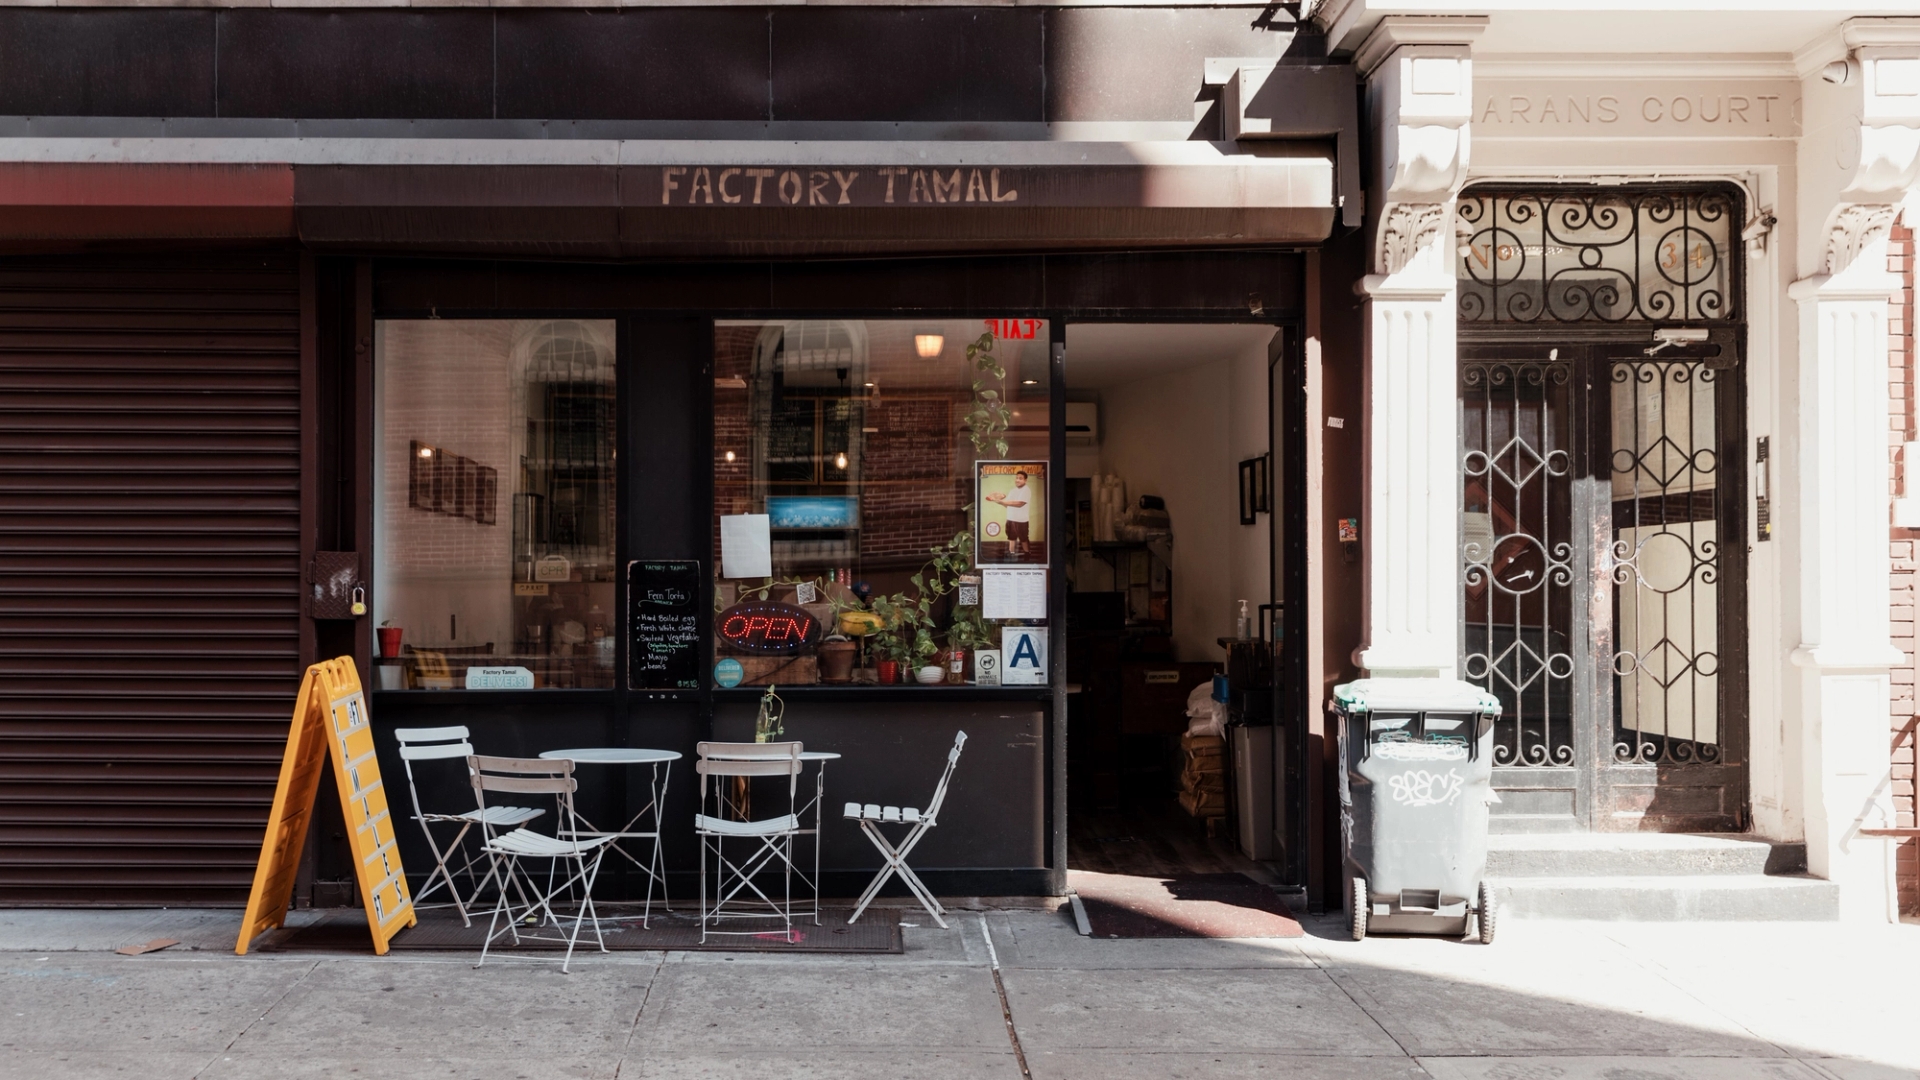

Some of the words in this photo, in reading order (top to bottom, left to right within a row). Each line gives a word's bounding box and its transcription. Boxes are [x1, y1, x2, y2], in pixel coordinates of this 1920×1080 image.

[1471, 95, 1619, 123] ARANS
[1641, 95, 1779, 123] COURT
[662, 167, 859, 206] FACTORY
[877, 167, 1018, 204] TAMAL
[984, 465, 1016, 474] FACTORY
[541, 565, 564, 576] CPR
[665, 587, 685, 600] Torta
[659, 614, 679, 622] Boiled
[682, 616, 696, 626] egg
[723, 615, 810, 640] OPEN
[1009, 634, 1040, 668] A
[648, 653, 668, 664] Mayo
[471, 676, 527, 687] DELIVERS!
